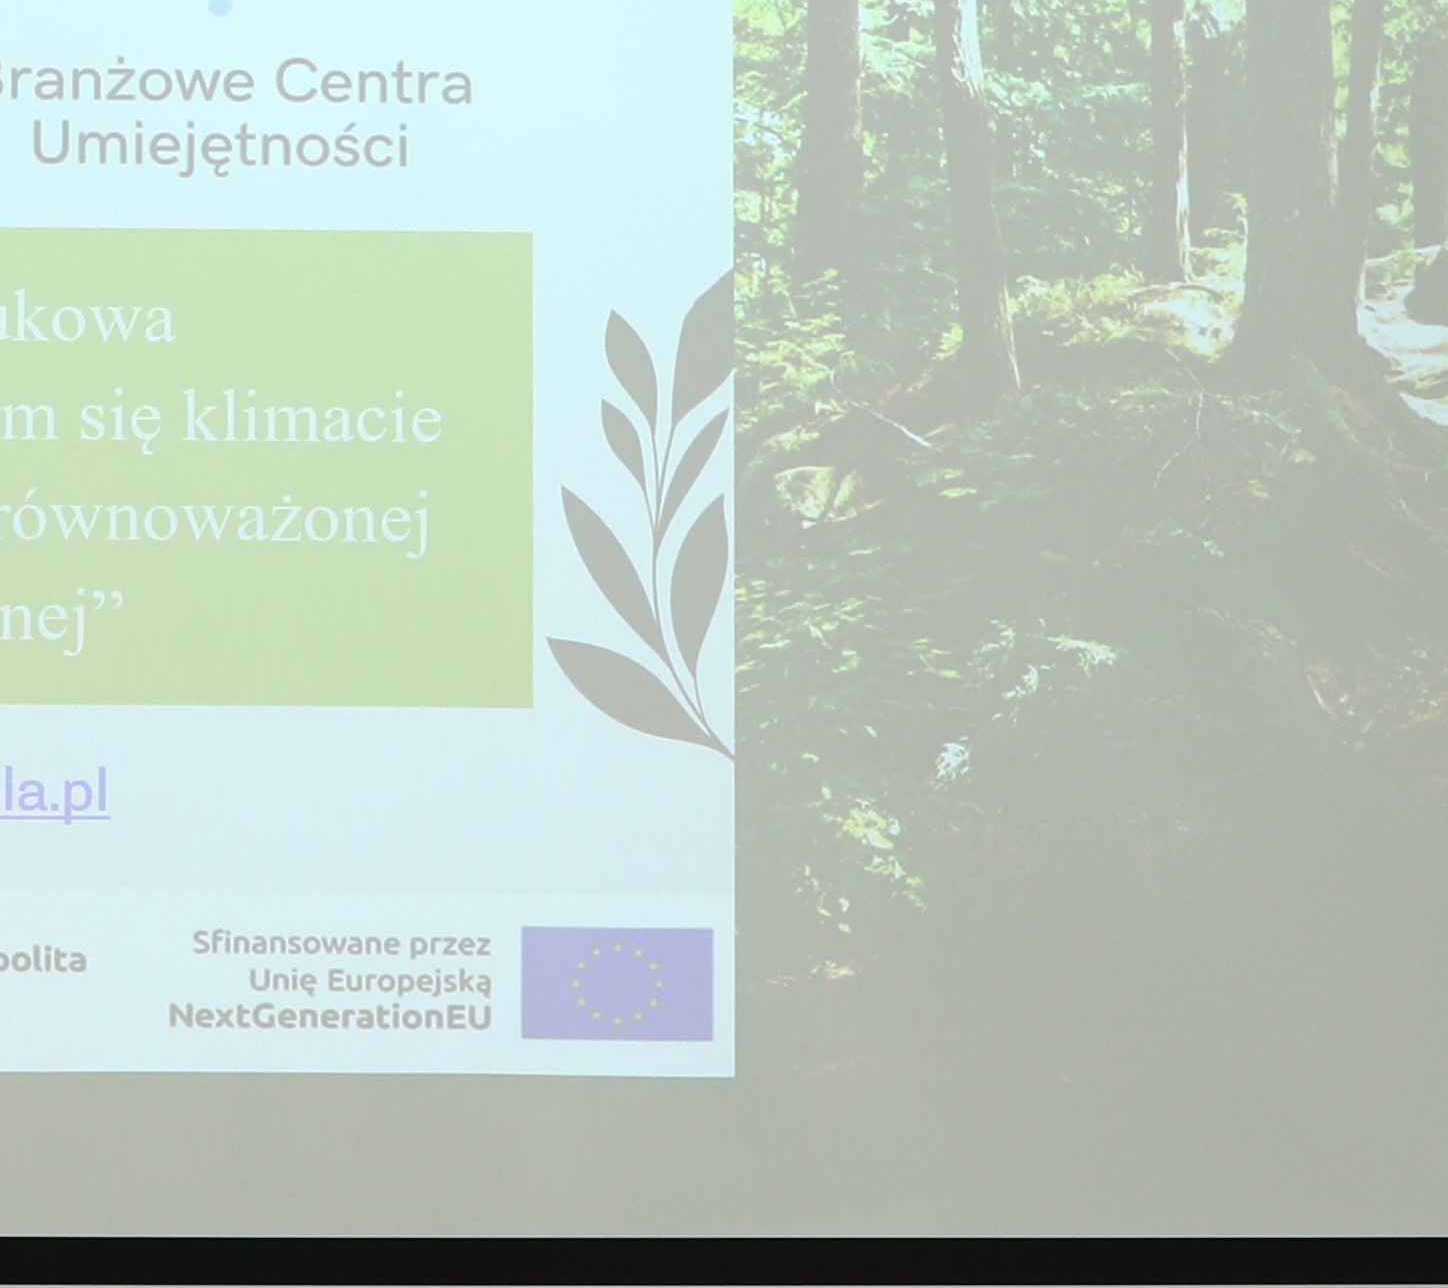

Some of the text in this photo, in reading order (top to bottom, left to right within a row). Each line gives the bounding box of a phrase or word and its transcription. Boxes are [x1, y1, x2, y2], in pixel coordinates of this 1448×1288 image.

[275, 57, 473, 105] Centra
[32, 119, 409, 178] Umiejętności
[78, 386, 163, 455] się
[180, 387, 443, 443] klimacie
[192, 929, 492, 960] Sfinansowane przez
[249, 968, 493, 997] Unię Europejską
[169, 1003, 492, 1030] NextGenerationEU
